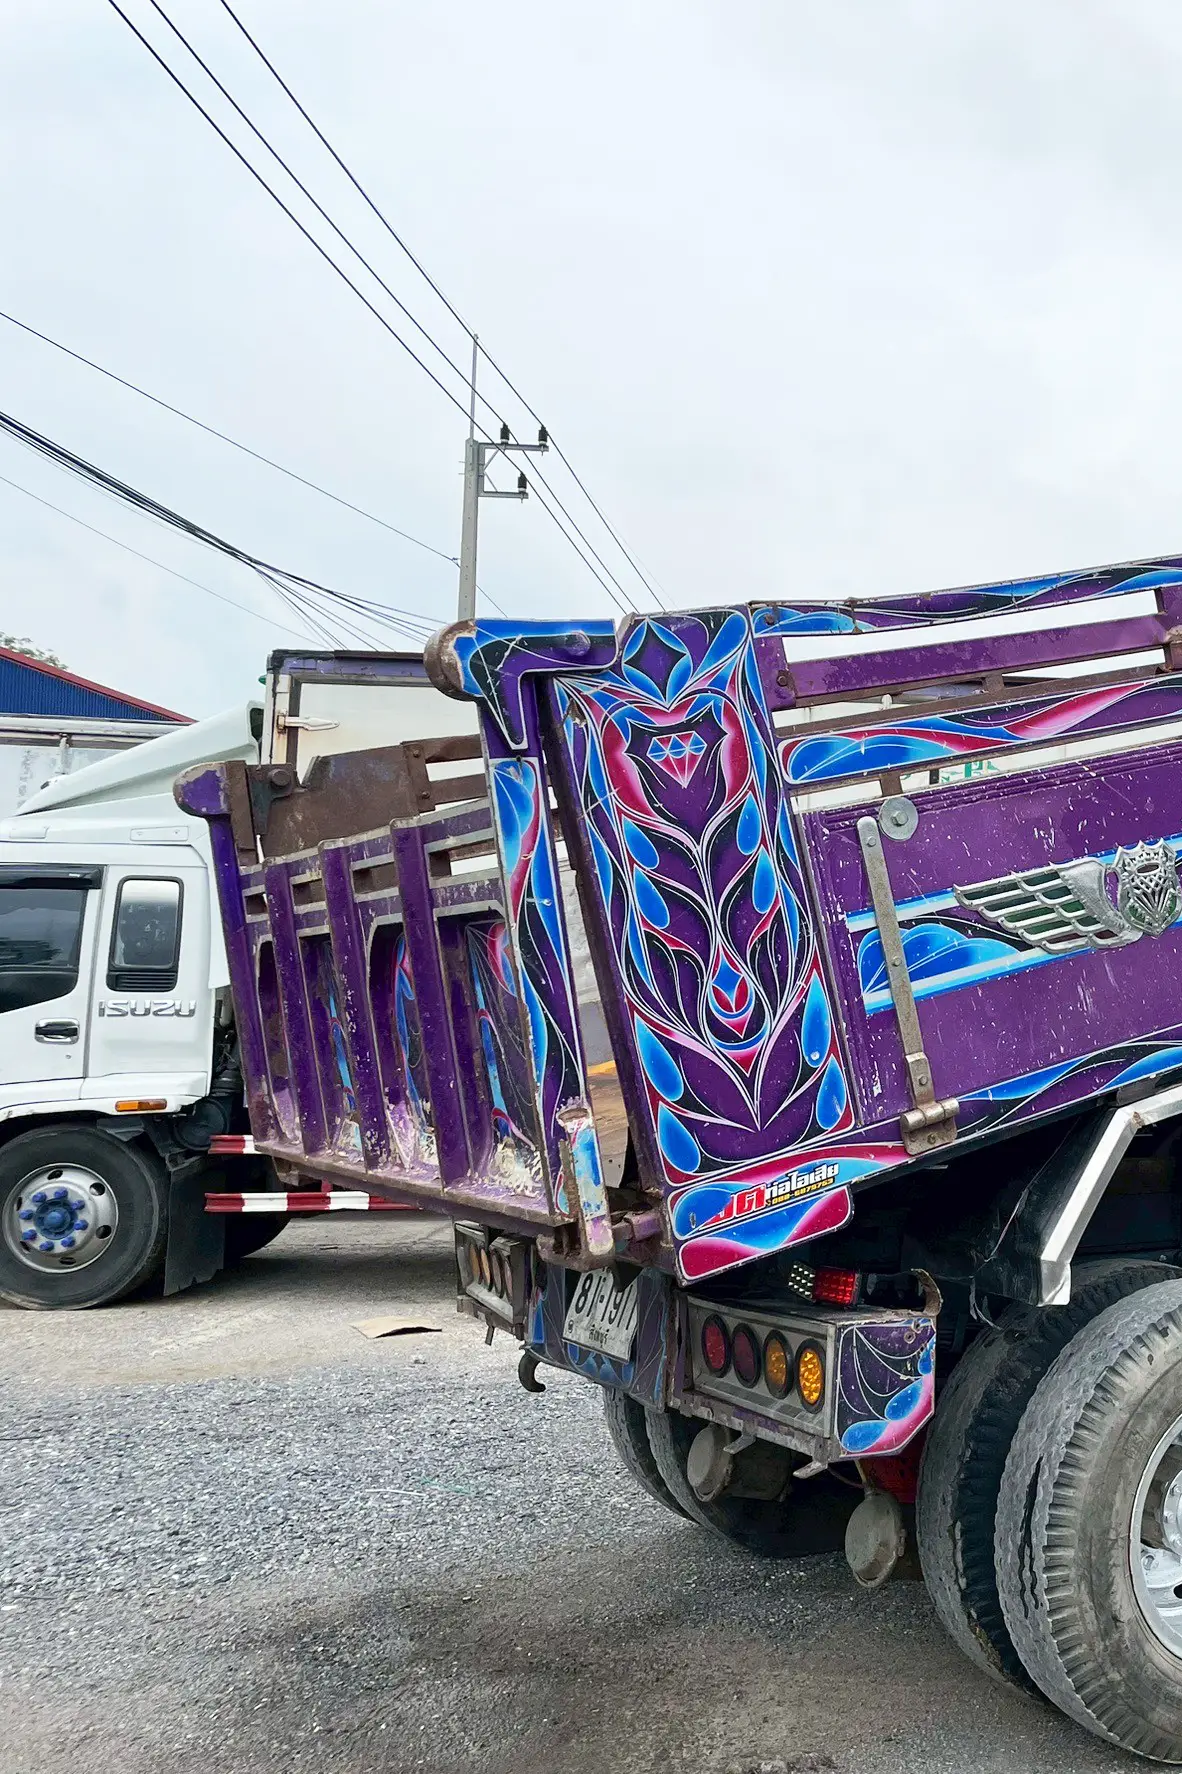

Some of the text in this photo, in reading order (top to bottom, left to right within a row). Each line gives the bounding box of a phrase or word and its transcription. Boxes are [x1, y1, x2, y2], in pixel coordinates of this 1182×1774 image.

[98, 1000, 196, 1017] ISUZU
[765, 1163, 839, 1199] ท่อไอเสีย
